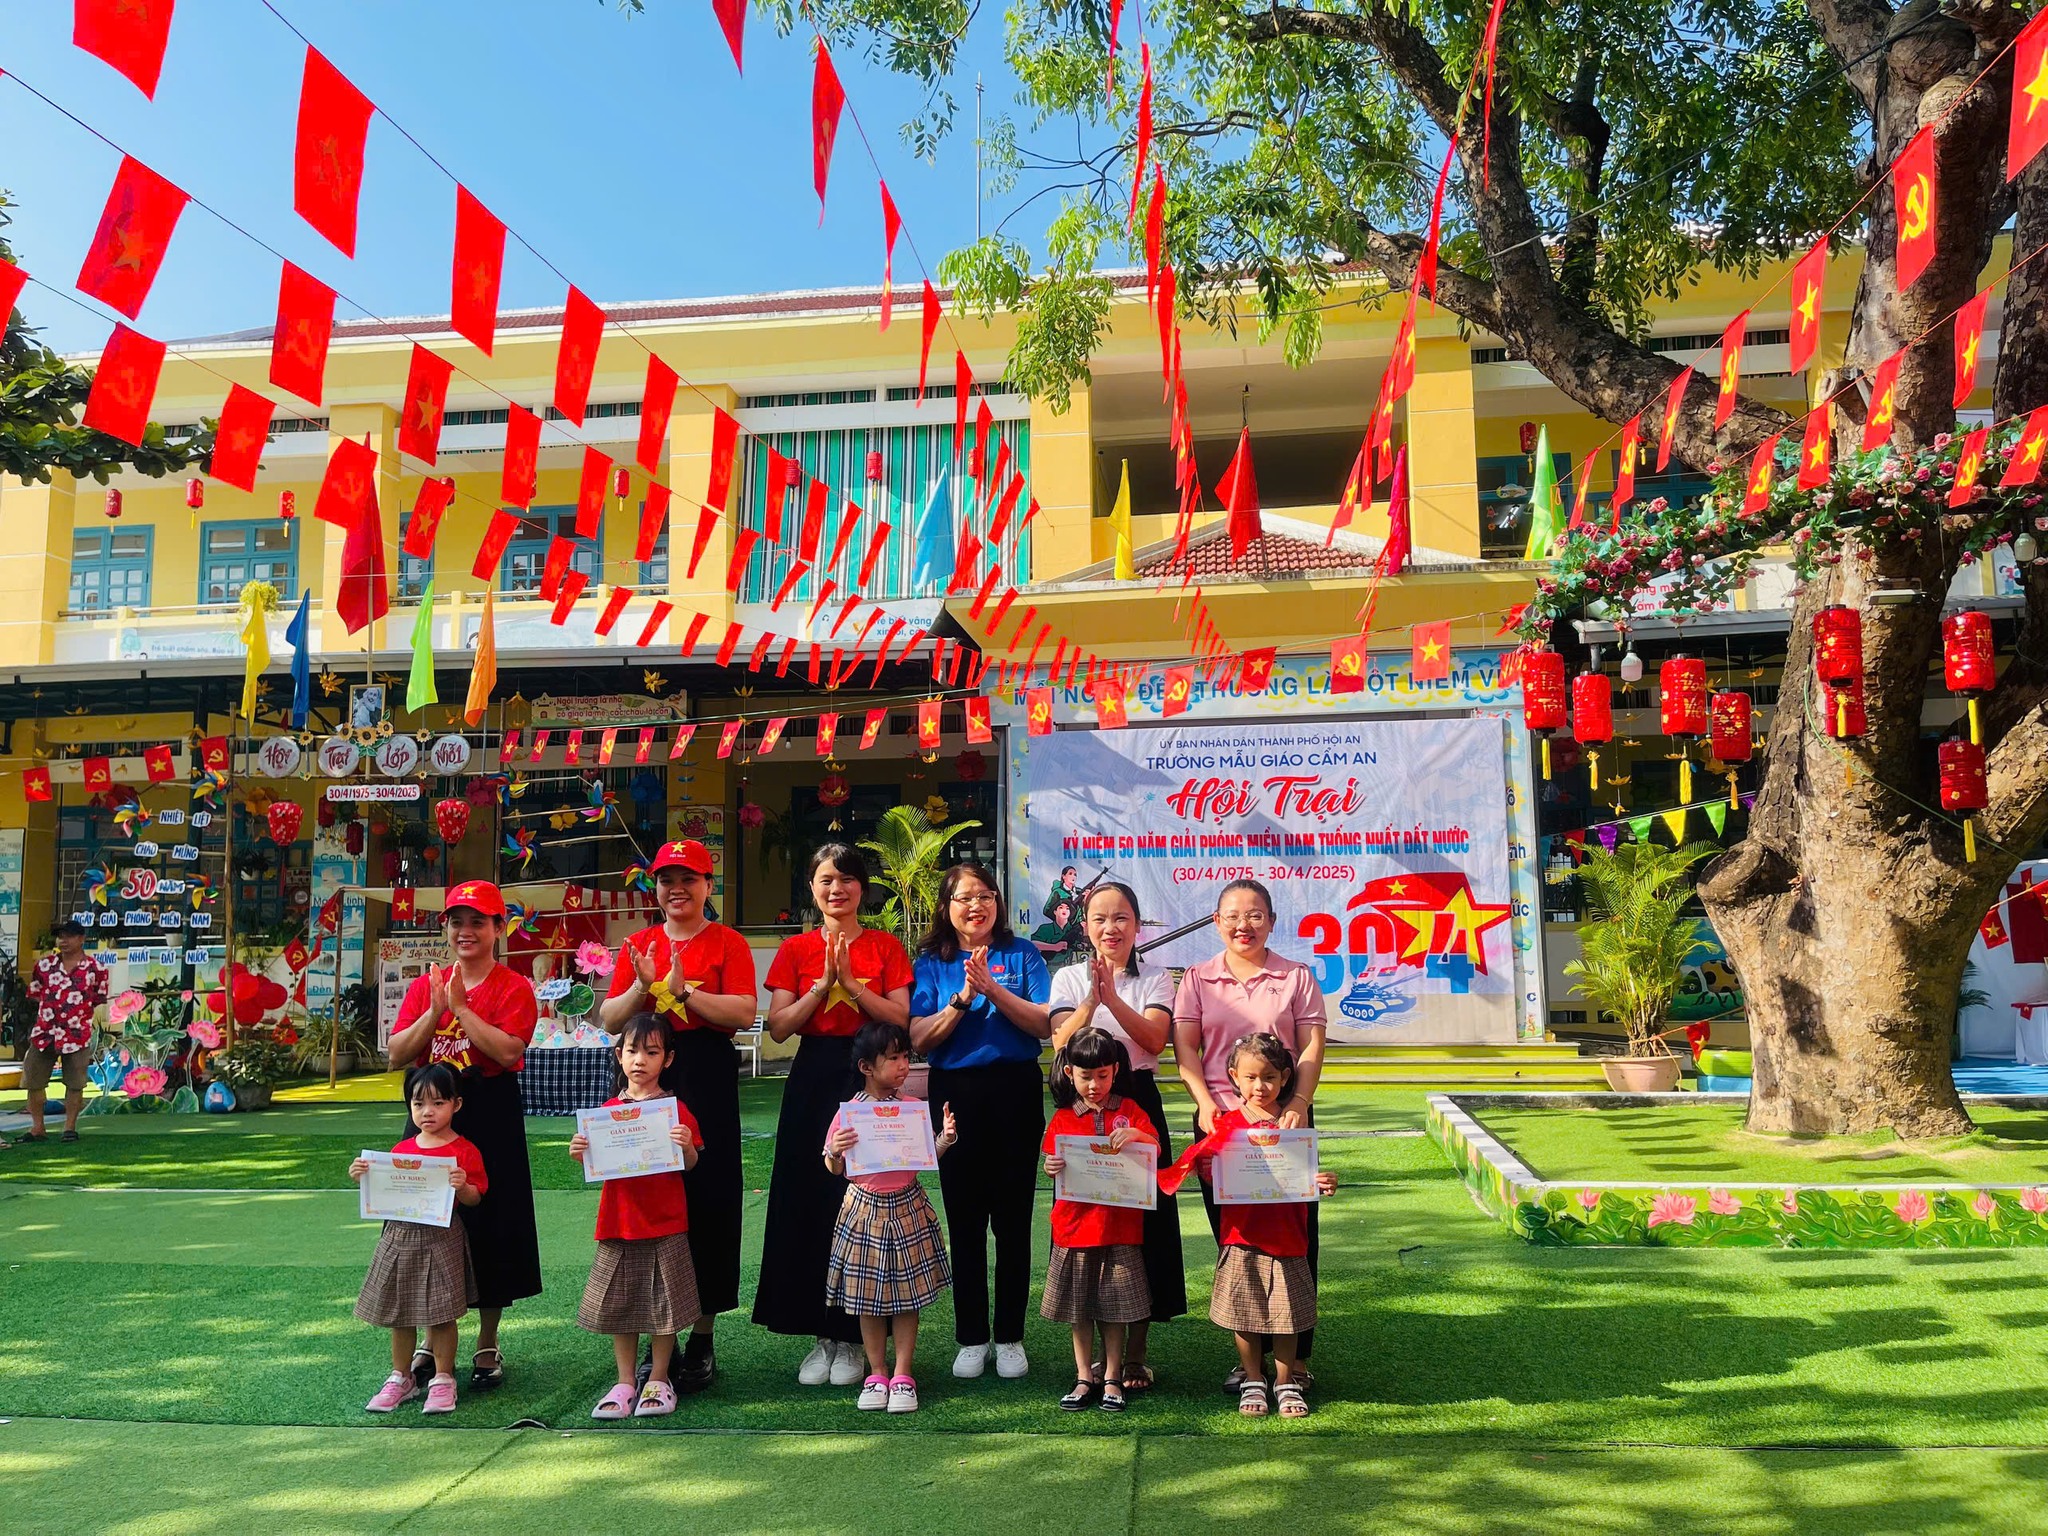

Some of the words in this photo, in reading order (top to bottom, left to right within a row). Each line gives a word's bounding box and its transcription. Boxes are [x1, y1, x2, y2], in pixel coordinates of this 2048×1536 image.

[1176, 739, 1198, 749] BAN
[1200, 737, 1231, 748] NHÂN
[1233, 736, 1255, 748] DÂN
[1258, 735, 1294, 747] THÀNH
[1297, 733, 1321, 746] PHỐ
[1322, 735, 1343, 747] HỘI
[1344, 735, 1361, 745] AN
[1146, 753, 1215, 770] TRƯỜNG
[1219, 749, 1256, 769] MẪU
[1260, 751, 1304, 767] GIÁO
[1308, 747, 1348, 766] CẨM
[1352, 751, 1377, 765] AN
[1166, 777, 1258, 823] Hội
[1262, 773, 1365, 822] Trại
[1063, 829, 1079, 860] KỶ
[1082, 832, 1115, 864] NIỆM
[1118, 835, 1135, 859] 50
[1137, 831, 1167, 859] NĂM
[1170, 828, 1197, 858] GIẢI
[1199, 830, 1244, 858] PHÓNG
[1247, 826, 1281, 857] MIỀN
[1284, 832, 1316, 857] NAM
[1318, 824, 1363, 856] THỐNG
[1365, 823, 1400, 855] NHẤT
[1403, 822, 1429, 854] ĐẤT
[1432, 825, 1470, 854] NƯỚC
[122, 869, 157, 899] 50
[1172, 866, 1254, 885] (30/4/1975
[1268, 865, 1355, 883] 30/4/2025)
[192, 914, 210, 926] NAM
